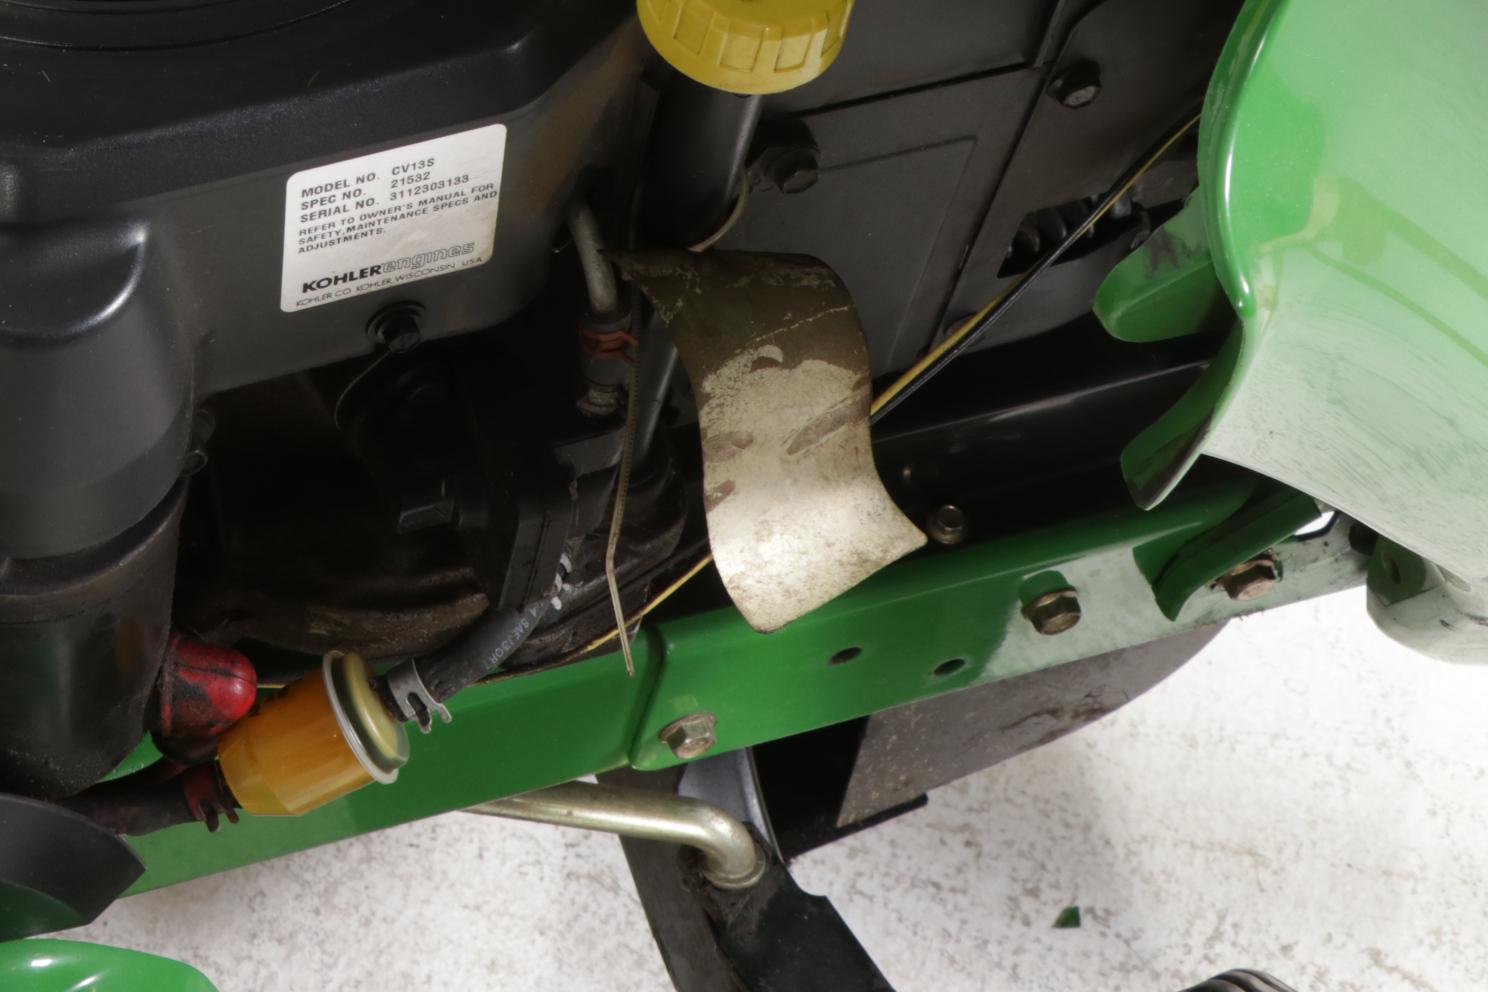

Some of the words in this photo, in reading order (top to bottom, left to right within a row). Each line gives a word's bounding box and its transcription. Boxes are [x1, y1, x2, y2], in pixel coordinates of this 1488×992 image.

[301, 179, 350, 198] MODEL
[356, 172, 380, 185] NO.
[391, 158, 435, 177] CV13S
[301, 194, 336, 211] SPEC
[342, 189, 366, 201] NO.
[390, 171, 431, 189] 21532
[299, 221, 336, 237] REFER
[341, 217, 355, 226] TO
[359, 201, 413, 223] OWNER'S
[418, 191, 467, 207] MANUAL
[471, 182, 494, 194] FOR
[300, 205, 349, 223] SERIAL
[355, 197, 379, 211] NO.
[389, 174, 470, 202] 3112303133
[433, 198, 469, 212] SPECS
[473, 190, 497, 201] AND
[298, 227, 386, 254] ADJUSTMENTS.
[296, 289, 332, 307] KOHLER
[394, 263, 456, 282] WISCONSIN
